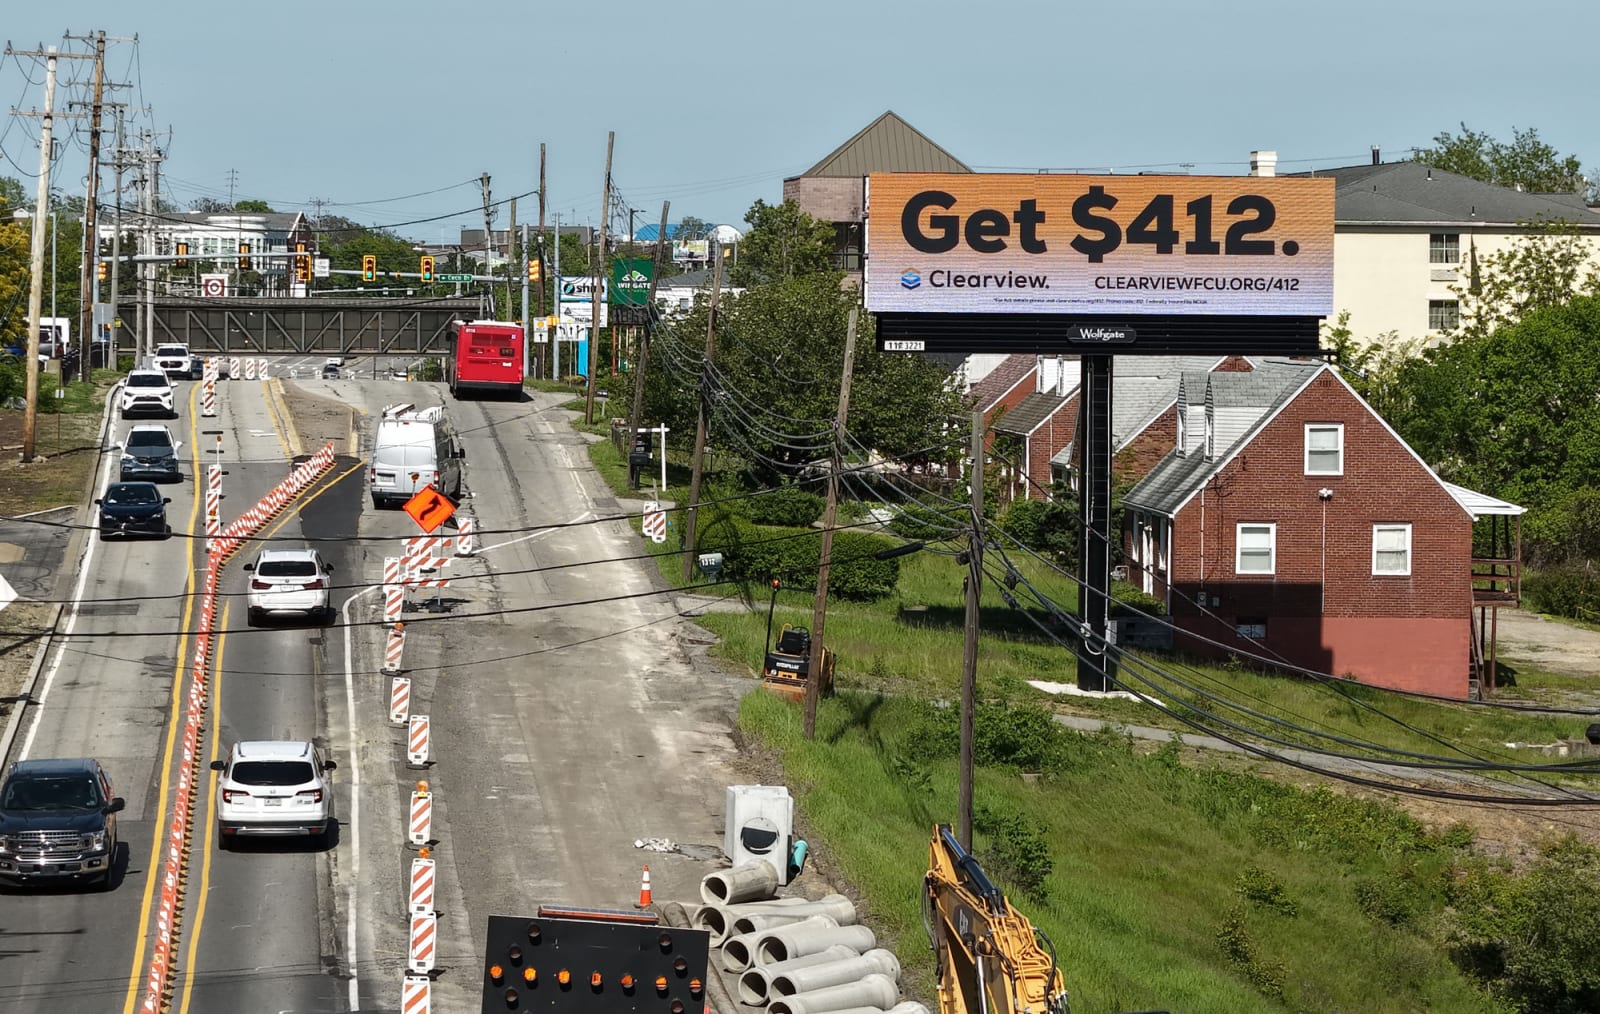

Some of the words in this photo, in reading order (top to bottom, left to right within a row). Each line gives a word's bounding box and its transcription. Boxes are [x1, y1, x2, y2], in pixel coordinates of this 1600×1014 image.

[901, 190, 1048, 254] Get
[1070, 185, 1300, 263] $412.
[929, 270, 1050, 289] Clearview.
[1094, 276, 1300, 292] CLEARVIEWFCU.ORG/412
[1080, 328, 1125, 341] Wolfgate
